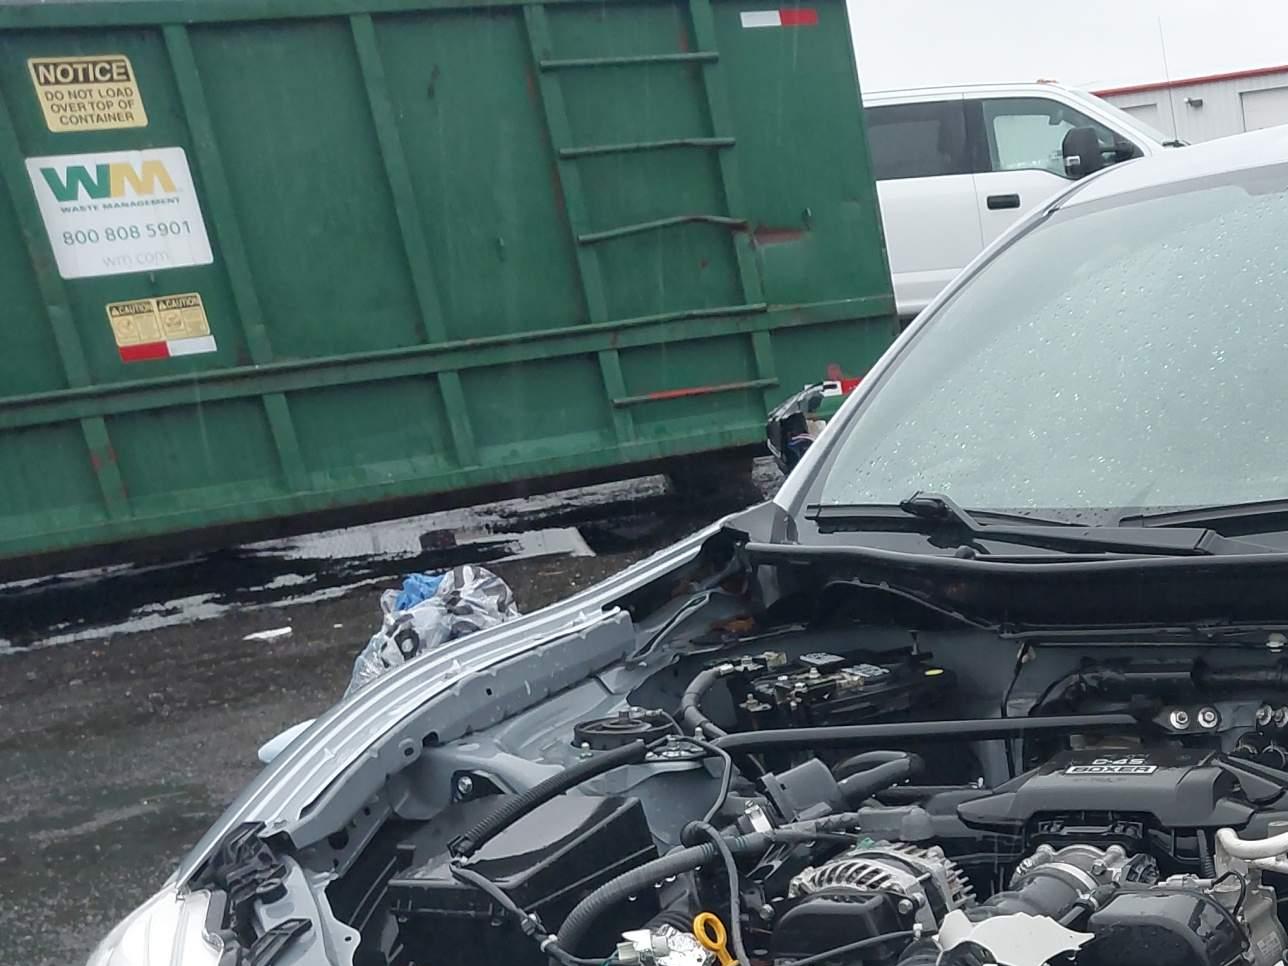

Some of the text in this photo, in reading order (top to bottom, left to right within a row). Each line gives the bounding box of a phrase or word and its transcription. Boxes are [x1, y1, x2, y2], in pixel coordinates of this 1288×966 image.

[39, 62, 128, 83] NOTICE
[45, 86, 133, 101] DO NOT LOAD
[51, 99, 134, 113] OVER TOP OF
[60, 112, 134, 125] CONTAINER
[40, 160, 176, 202] WM
[60, 197, 181, 213] WASTE MANAGEMENT
[62, 220, 191, 246] 800 808 5901
